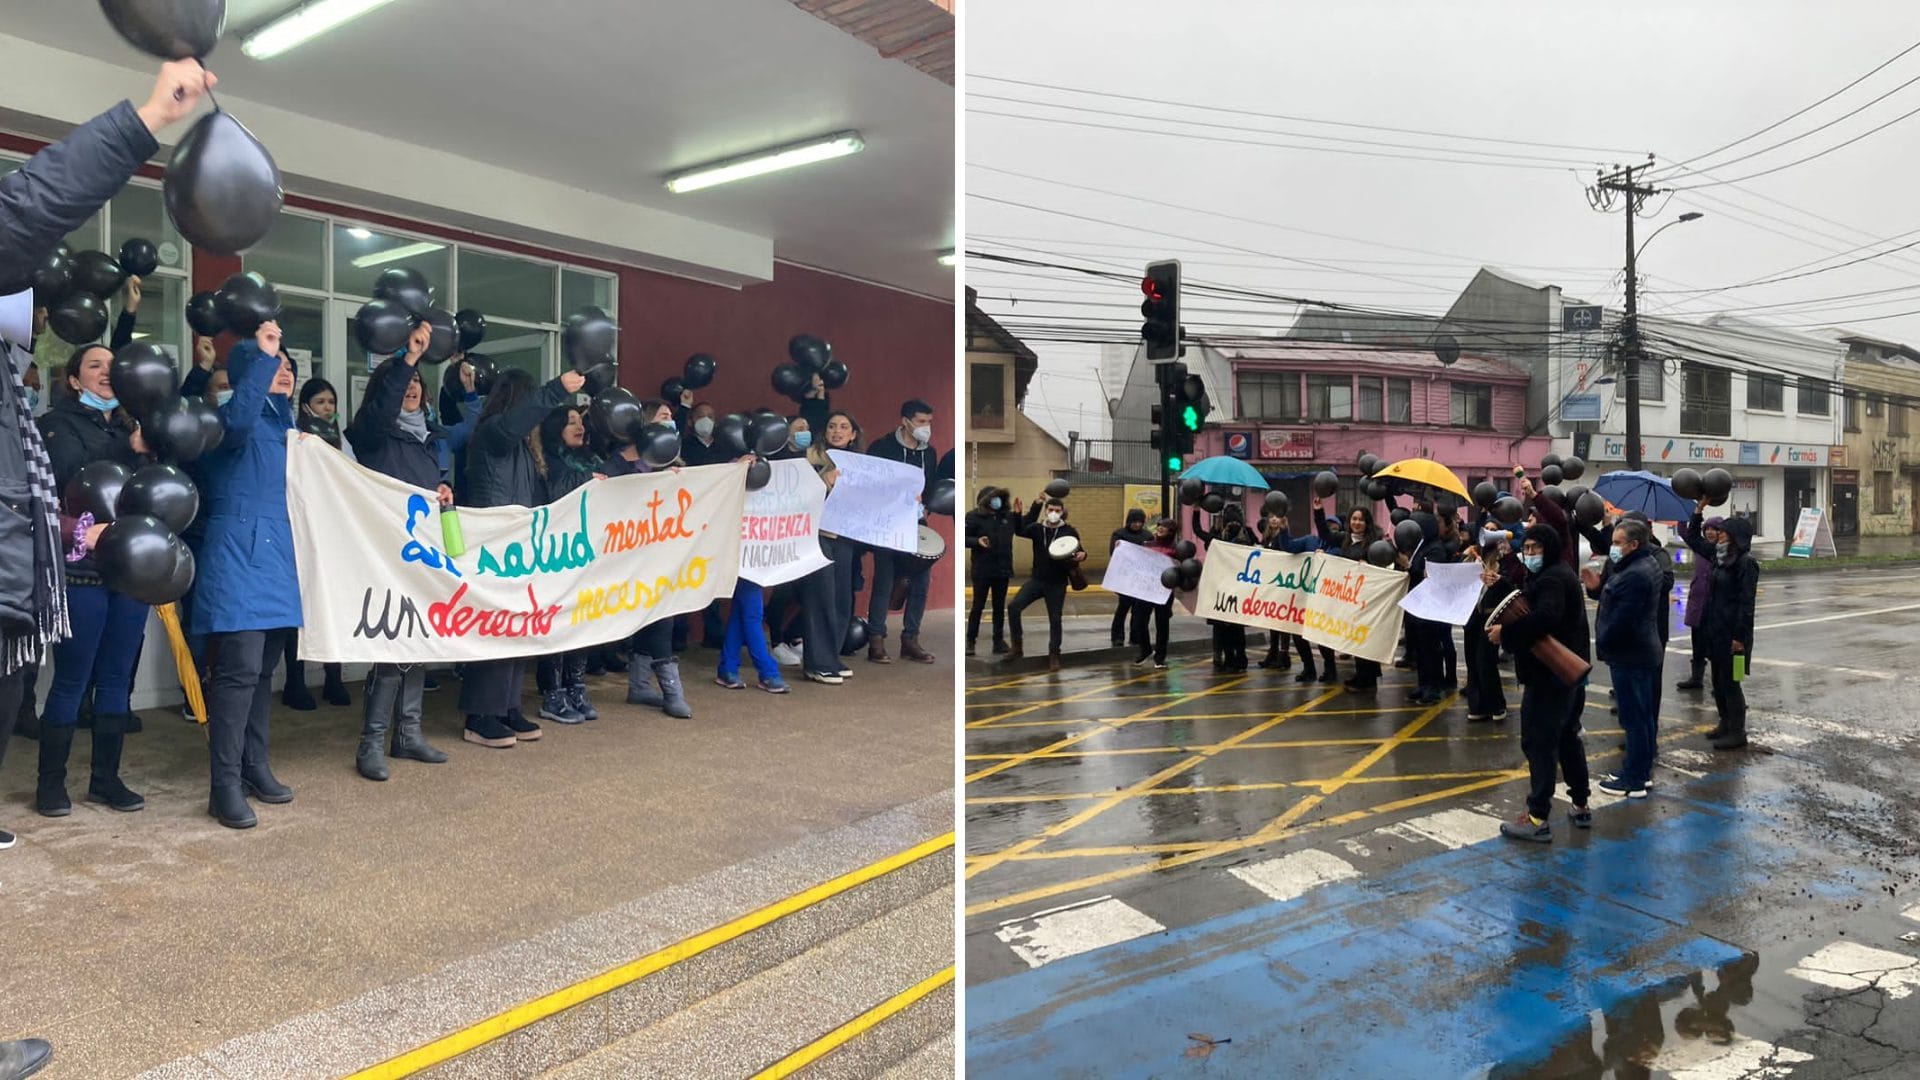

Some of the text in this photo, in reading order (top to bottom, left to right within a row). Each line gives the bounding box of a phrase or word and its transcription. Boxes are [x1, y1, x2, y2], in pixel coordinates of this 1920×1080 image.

[1604, 438, 1646, 456] Fars
[1689, 442, 1724, 458] Farmás
[1789, 447, 1818, 462] Farmás
[476, 490, 596, 577] salud
[740, 512, 812, 541] ERGUENZA
[742, 541, 800, 568] NACIONAL
[1237, 551, 1262, 584] La
[1268, 557, 1326, 594] sald
[428, 582, 562, 637] derecho
[1214, 592, 1238, 613] un
